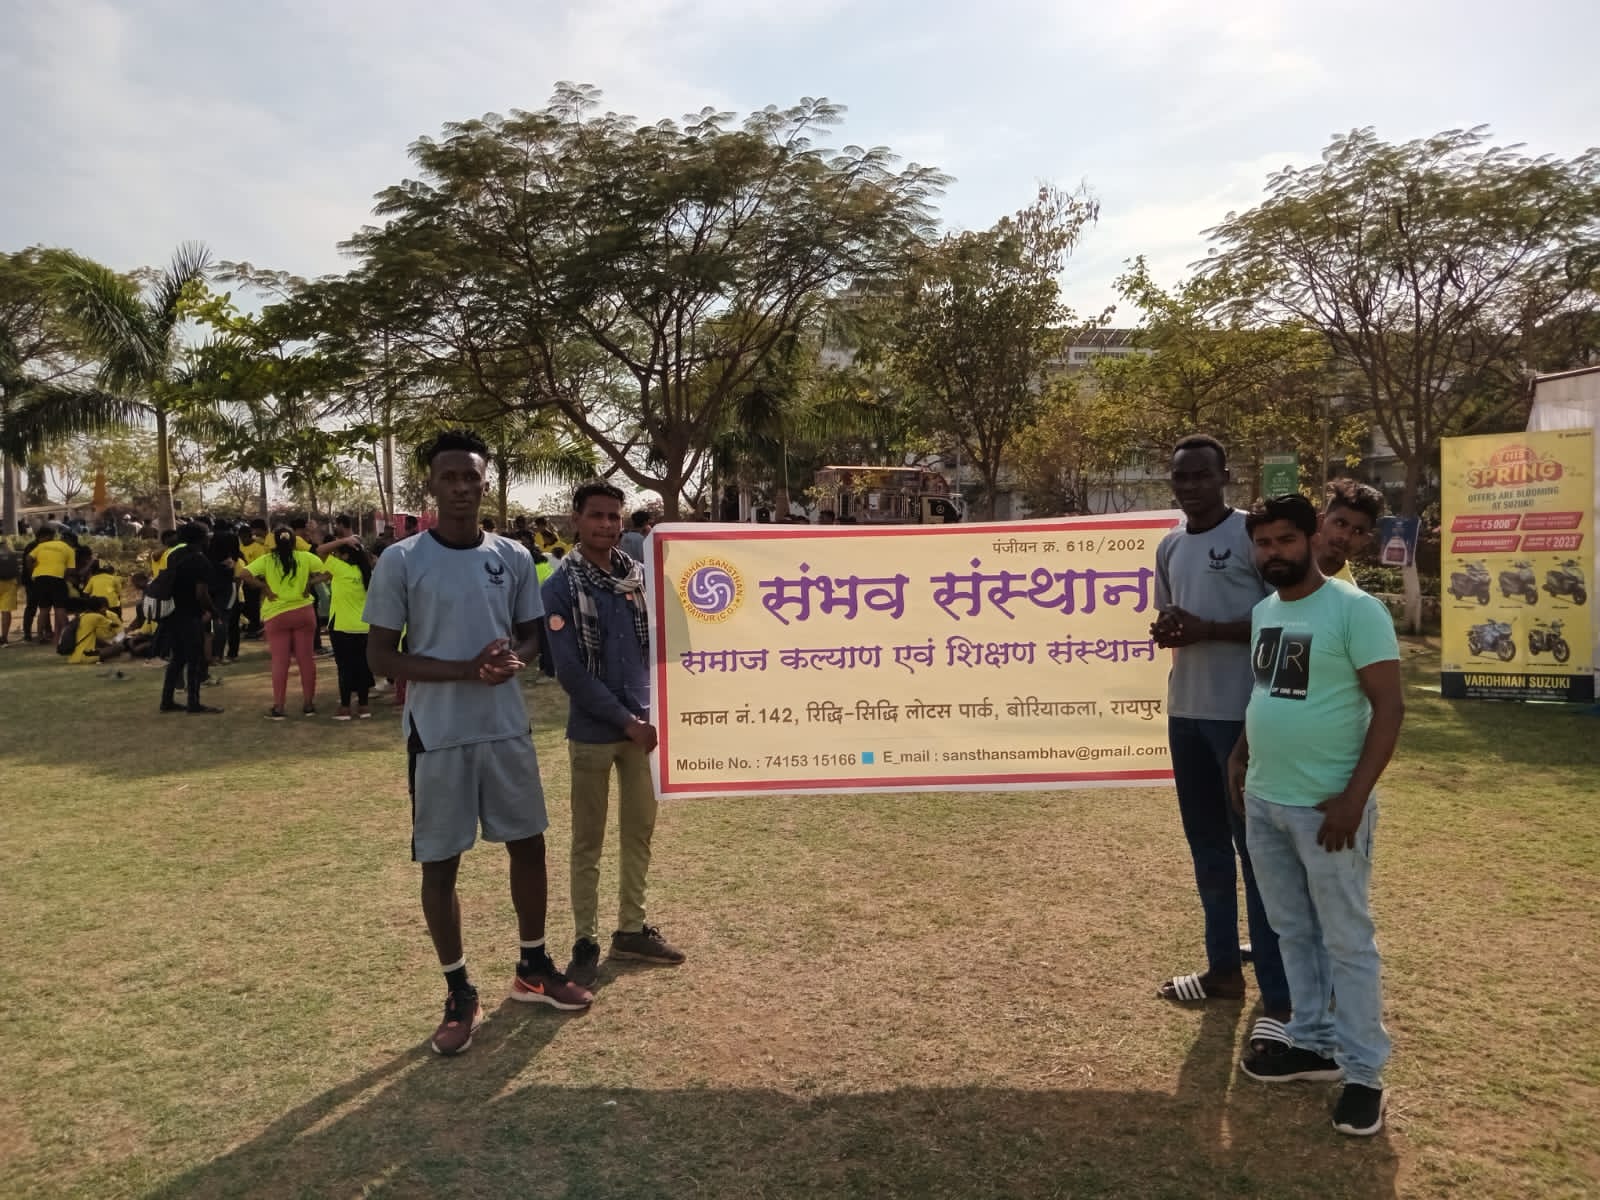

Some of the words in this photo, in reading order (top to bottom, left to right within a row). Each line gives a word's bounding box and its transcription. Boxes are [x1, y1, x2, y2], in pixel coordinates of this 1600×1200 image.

[1466, 460, 1562, 489] SPRING
[993, 538, 1038, 554] पंजीयन
[679, 559, 706, 598] SAMBHAV
[709, 558, 744, 596] SANSTHAN
[759, 562, 910, 626] संभव
[930, 557, 1154, 621] संस्थान
[685, 603, 716, 622] RAIPUR
[680, 649, 769, 675] समाज
[780, 646, 883, 671] कल्याण
[893, 637, 935, 674] एवं
[946, 636, 1036, 669] शिक्षण
[1047, 634, 1156, 665] संस्थान
[1464, 674, 1526, 687] VARDHMAN
[1529, 676, 1570, 689] SUZUKI
[680, 711, 729, 726] मकान
[905, 698, 952, 720] लोटस
[959, 697, 999, 720] पार्क,
[1007, 696, 1103, 718] बोरियाकला,
[1111, 699, 1162, 721] रायपुर
[676, 756, 724, 771] Mobile
[942, 745, 1168, 763] sansthansambhav@gmail.com
